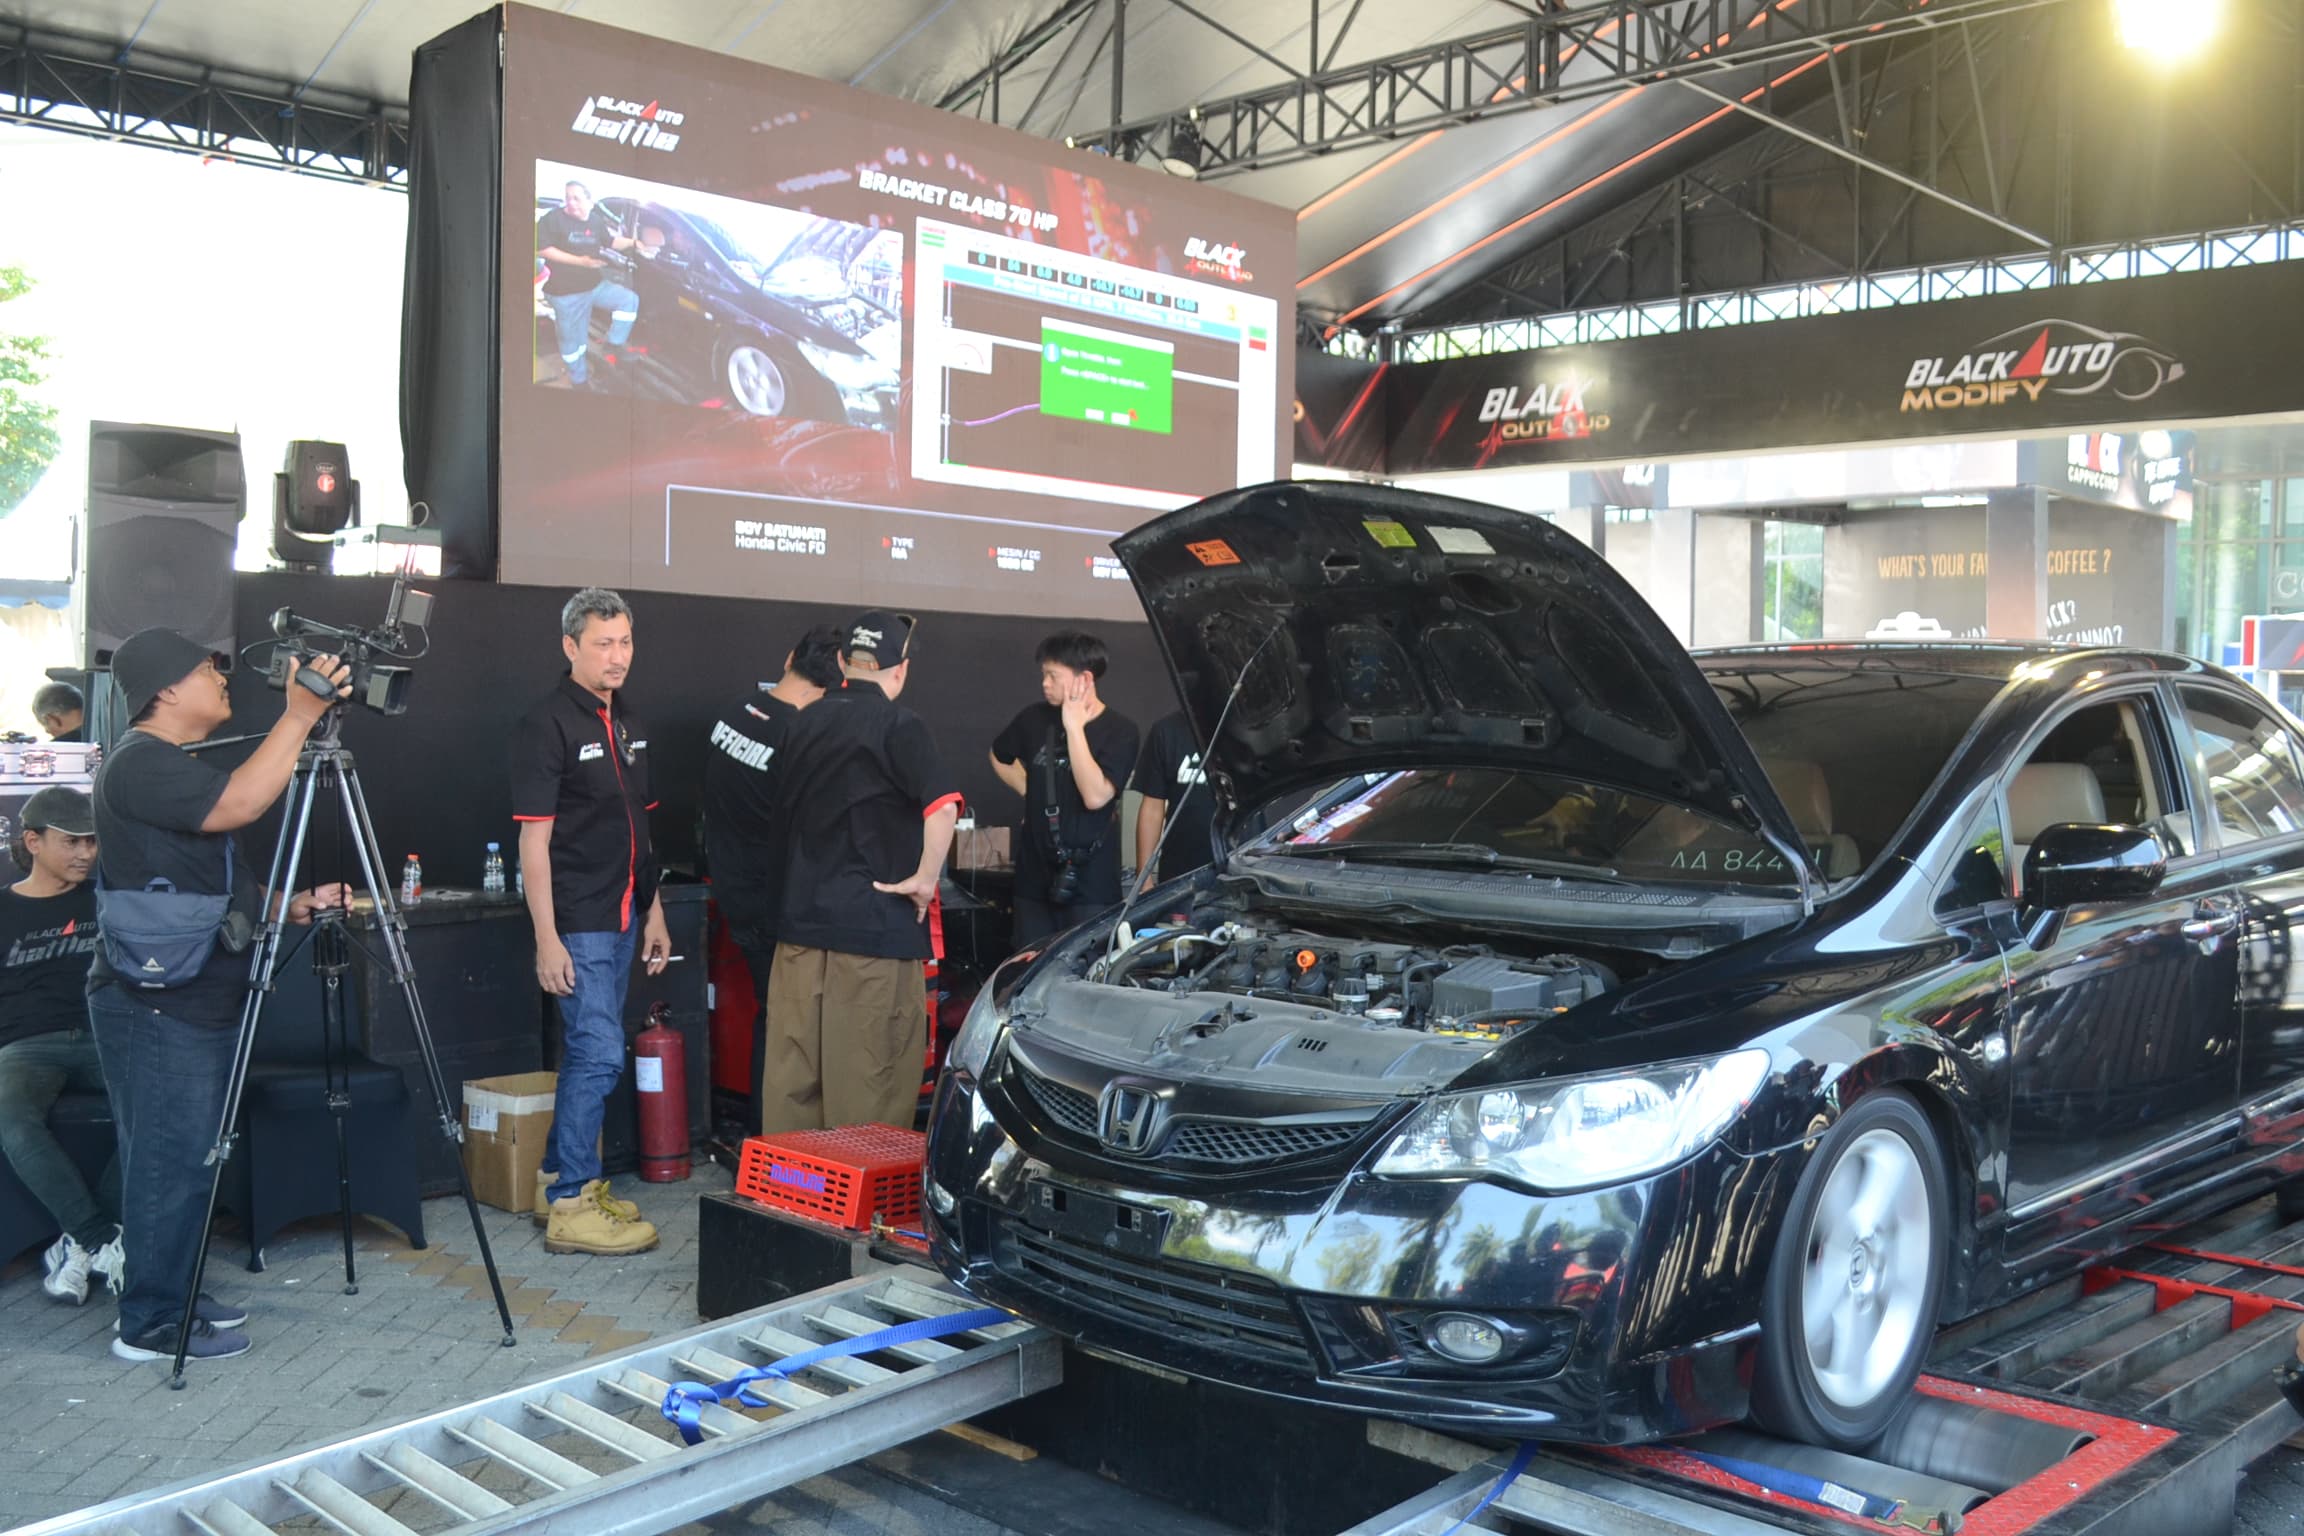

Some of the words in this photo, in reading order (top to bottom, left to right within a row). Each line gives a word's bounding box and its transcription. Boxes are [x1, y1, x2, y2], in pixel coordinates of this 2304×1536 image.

[859, 169, 948, 206] BRACKET
[949, 190, 1007, 221] CLASS
[1009, 204, 1032, 227] 70
[1033, 211, 1059, 232] HP
[1478, 378, 1593, 422] BLACK
[1900, 377, 2050, 413] MODIFY
[2067, 464, 2119, 494] CAPPUCCINO
[735, 534, 775, 551] Honda
[777, 538, 807, 554] Civic
[892, 536, 915, 549] TYPE
[1878, 553, 1927, 580] WHAT'S
[1930, 553, 1965, 578] YOUR
[2047, 548, 2097, 576] COFFEE
[710, 718, 775, 772] OFFICIAL
